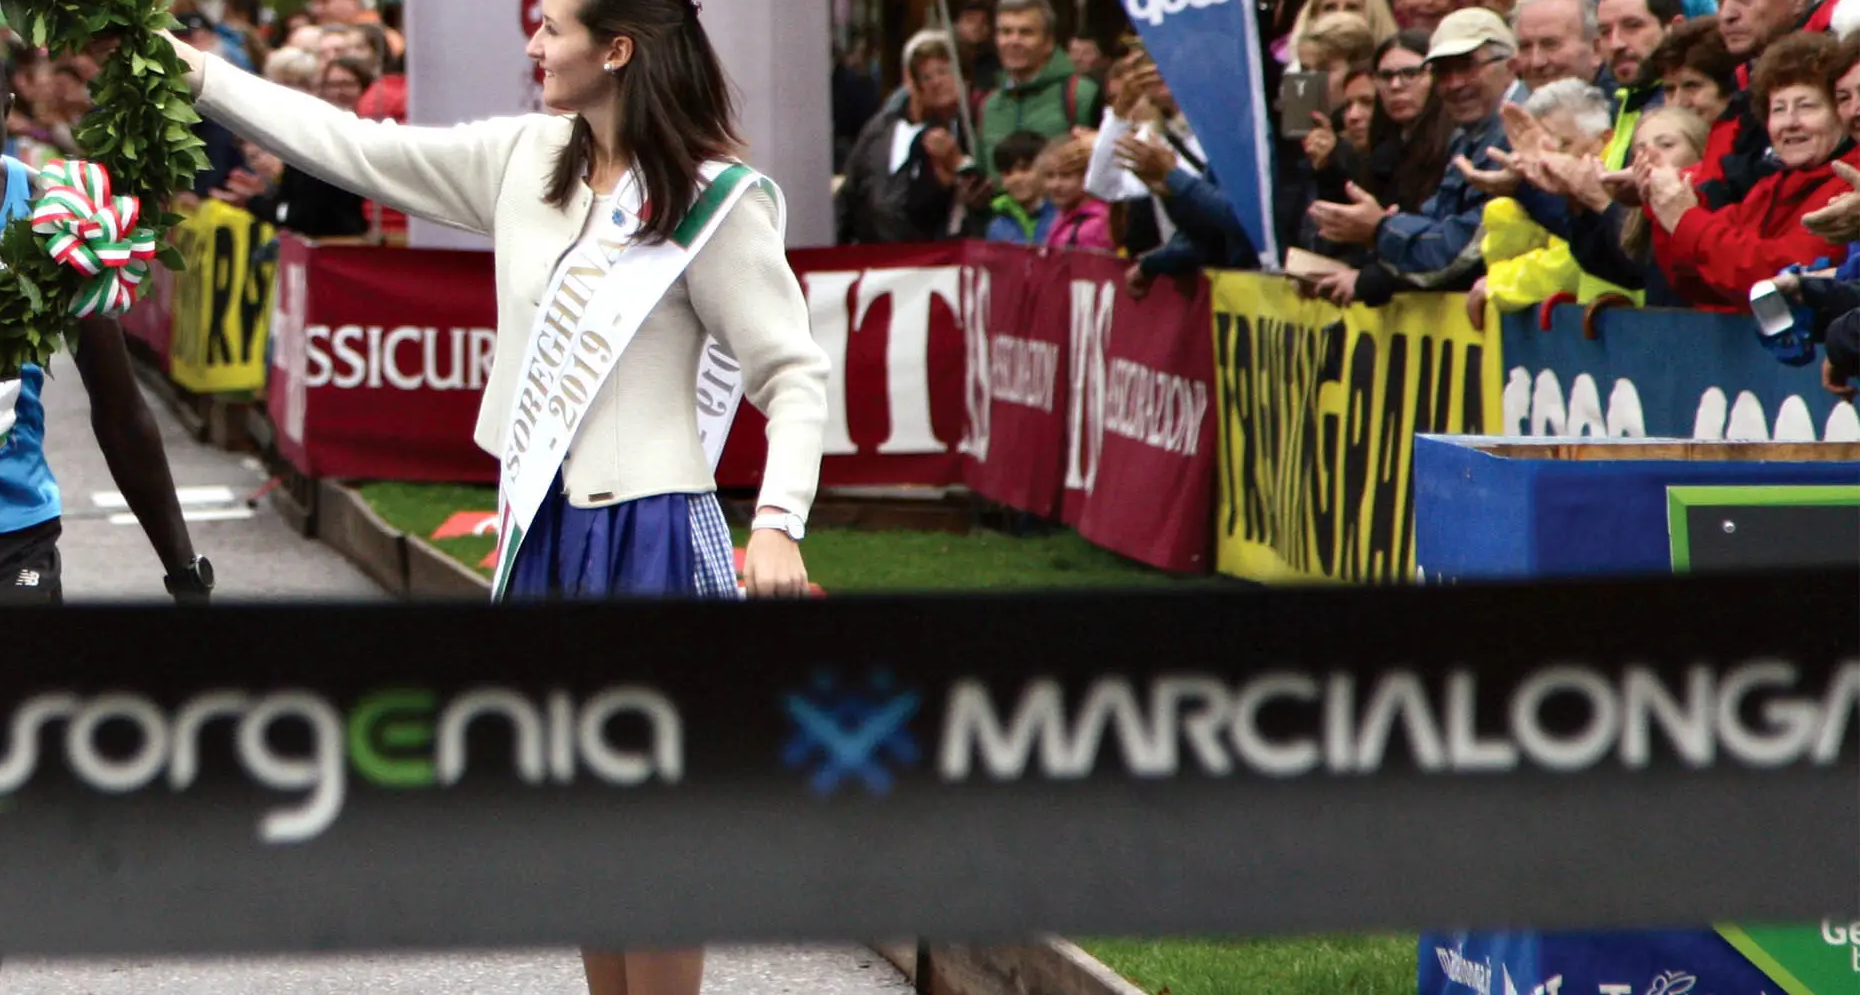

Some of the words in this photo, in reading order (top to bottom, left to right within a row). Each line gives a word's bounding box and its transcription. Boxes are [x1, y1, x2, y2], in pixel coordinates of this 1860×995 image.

[305, 324, 498, 391] SSICUR
[505, 237, 629, 483] SOREGHINA
[548, 329, 614, 433] 2019
[696, 343, 741, 418] 019
[802, 265, 966, 456] IT
